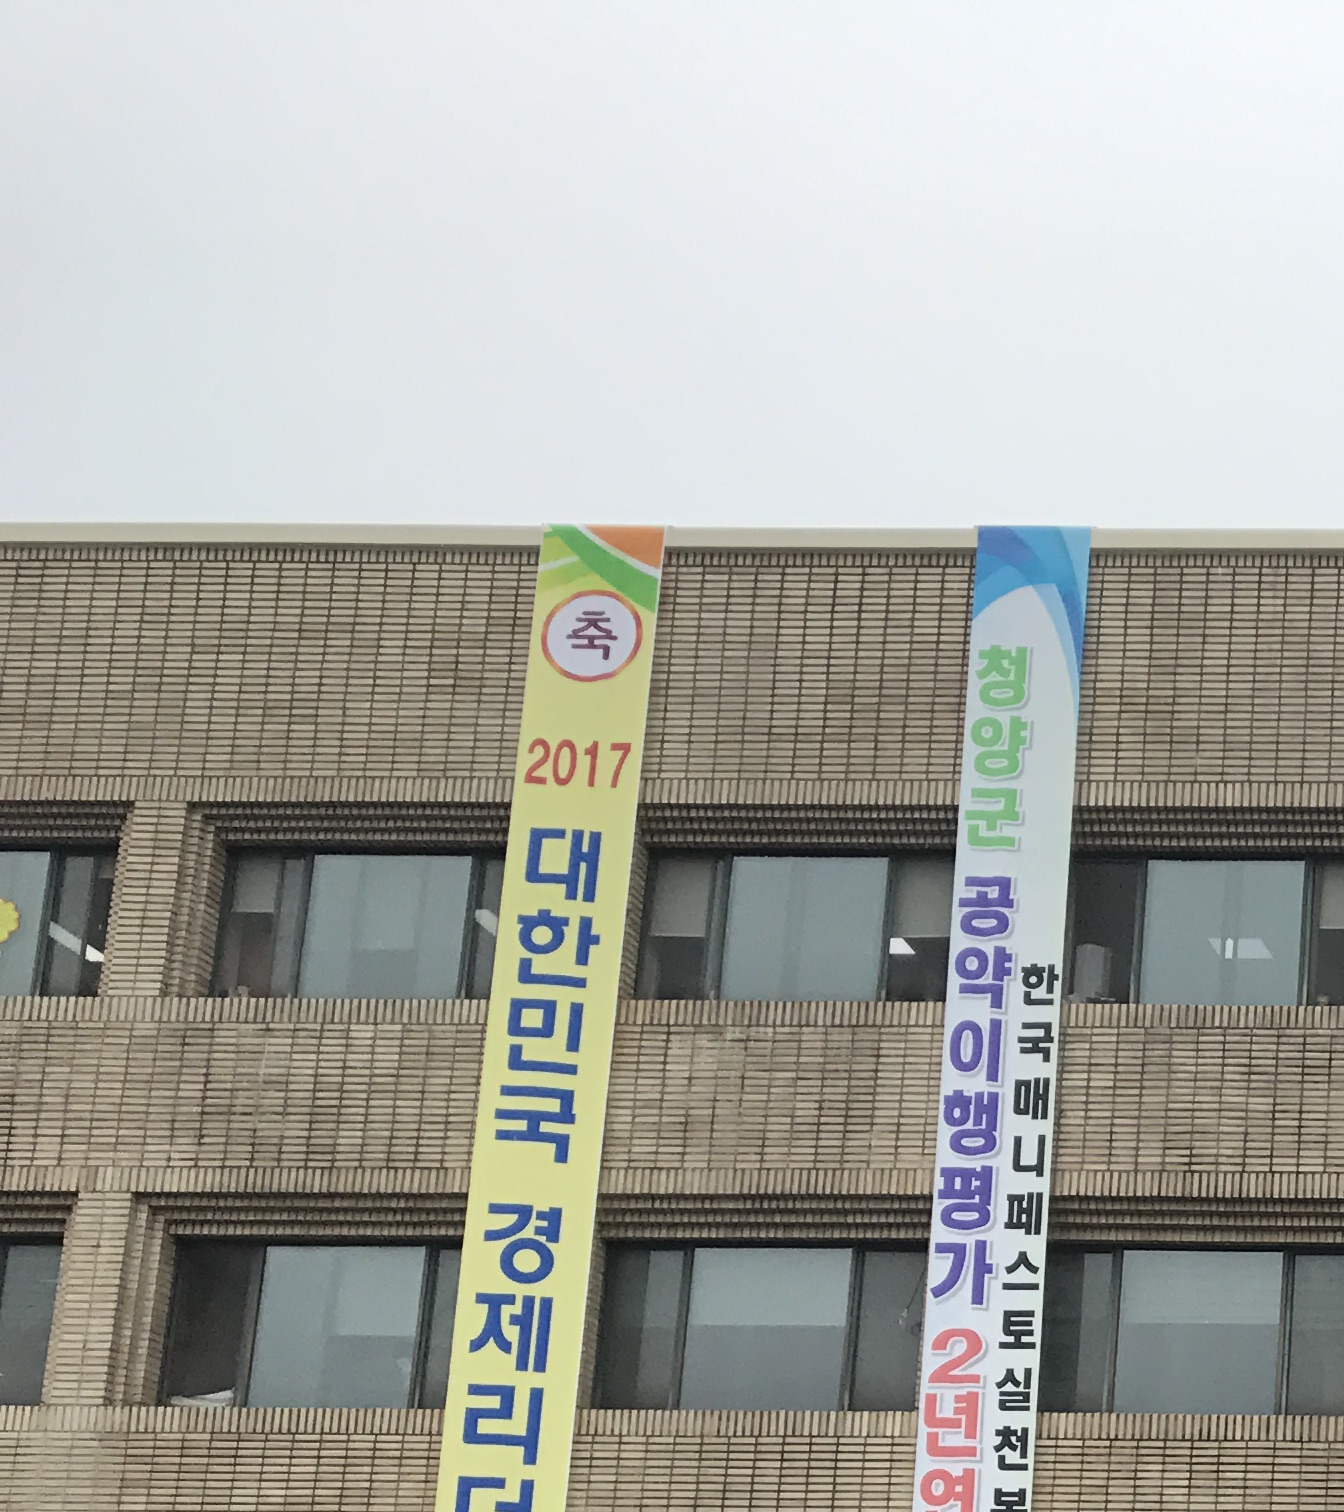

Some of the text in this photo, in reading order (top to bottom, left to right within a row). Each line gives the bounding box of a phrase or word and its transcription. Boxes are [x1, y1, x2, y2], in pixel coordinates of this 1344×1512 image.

[565, 608, 620, 662] 축
[522, 737, 634, 790] 2017
[963, 643, 1031, 851] 청양군
[493, 824, 602, 1165] 대한민국
[929, 875, 1015, 1307] 공약이행평가
